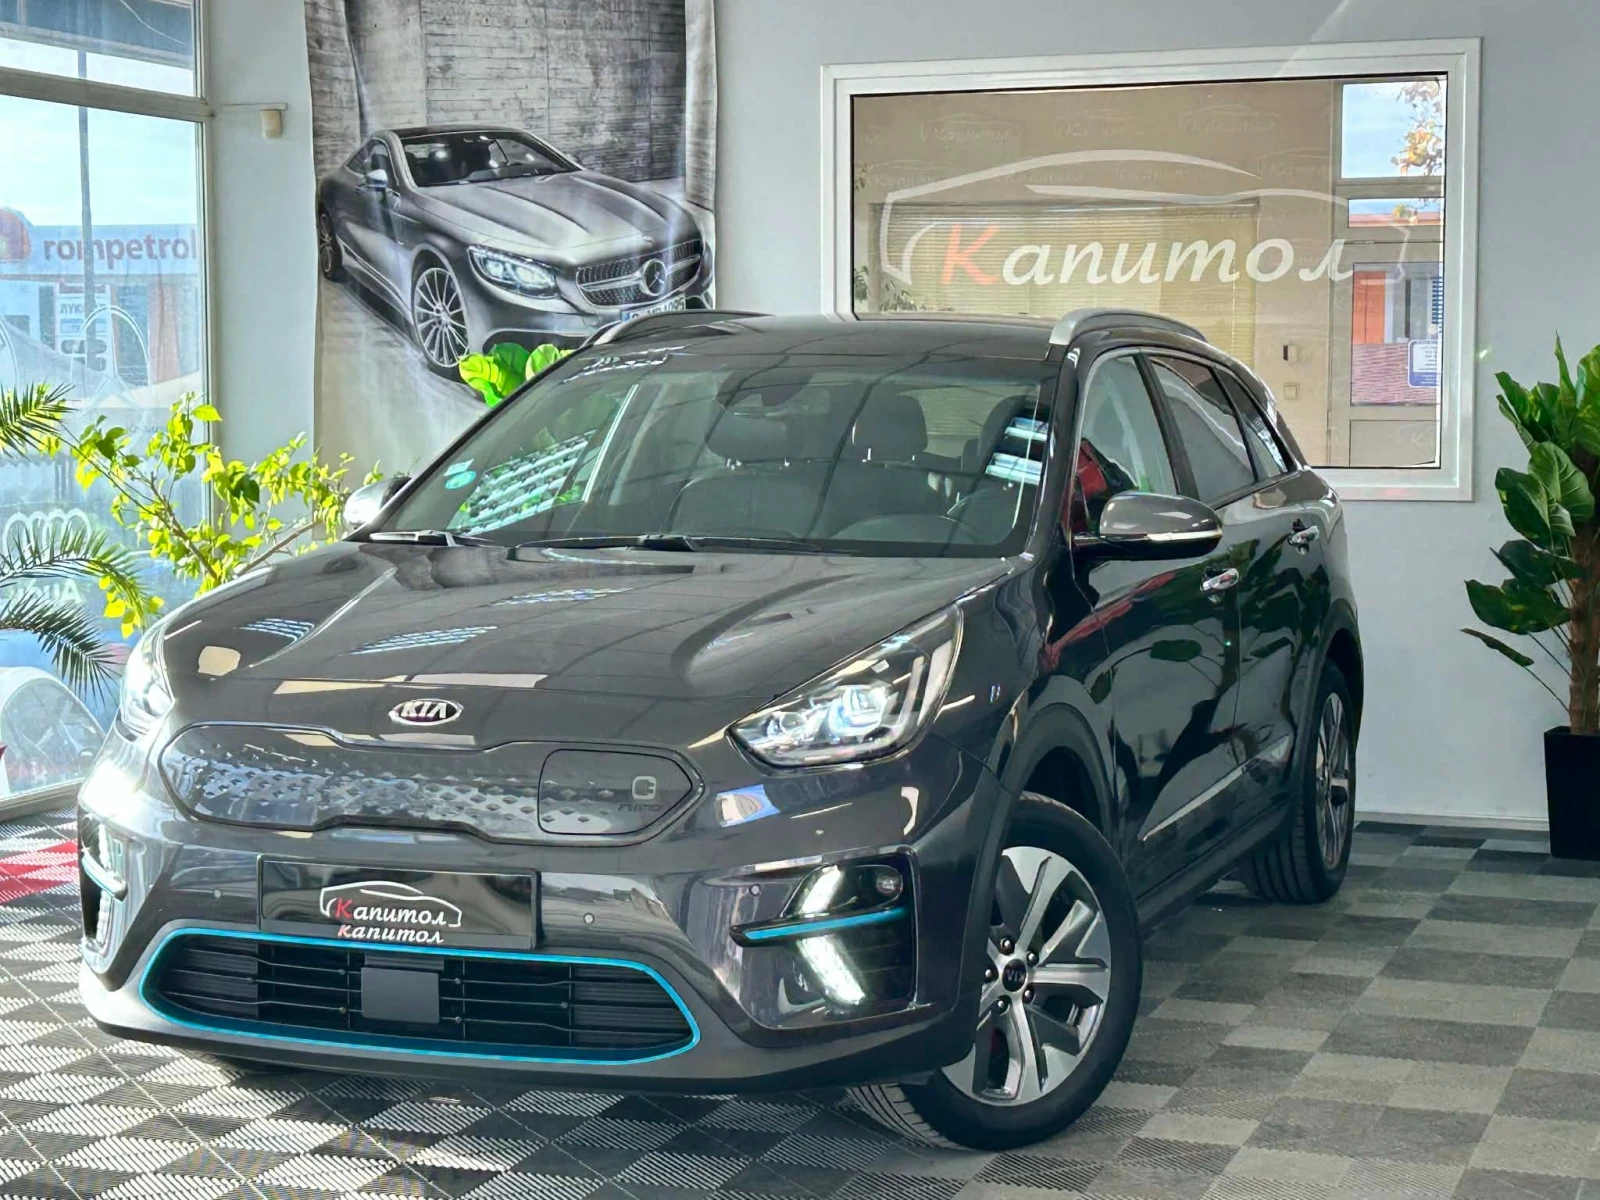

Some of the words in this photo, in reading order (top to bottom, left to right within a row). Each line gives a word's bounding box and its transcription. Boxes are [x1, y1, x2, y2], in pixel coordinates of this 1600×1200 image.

[43, 228, 197, 270] rompetrol
[941, 222, 1354, 286] Капитол
[400, 701, 447, 719] KIA
[335, 897, 447, 926] Капитол
